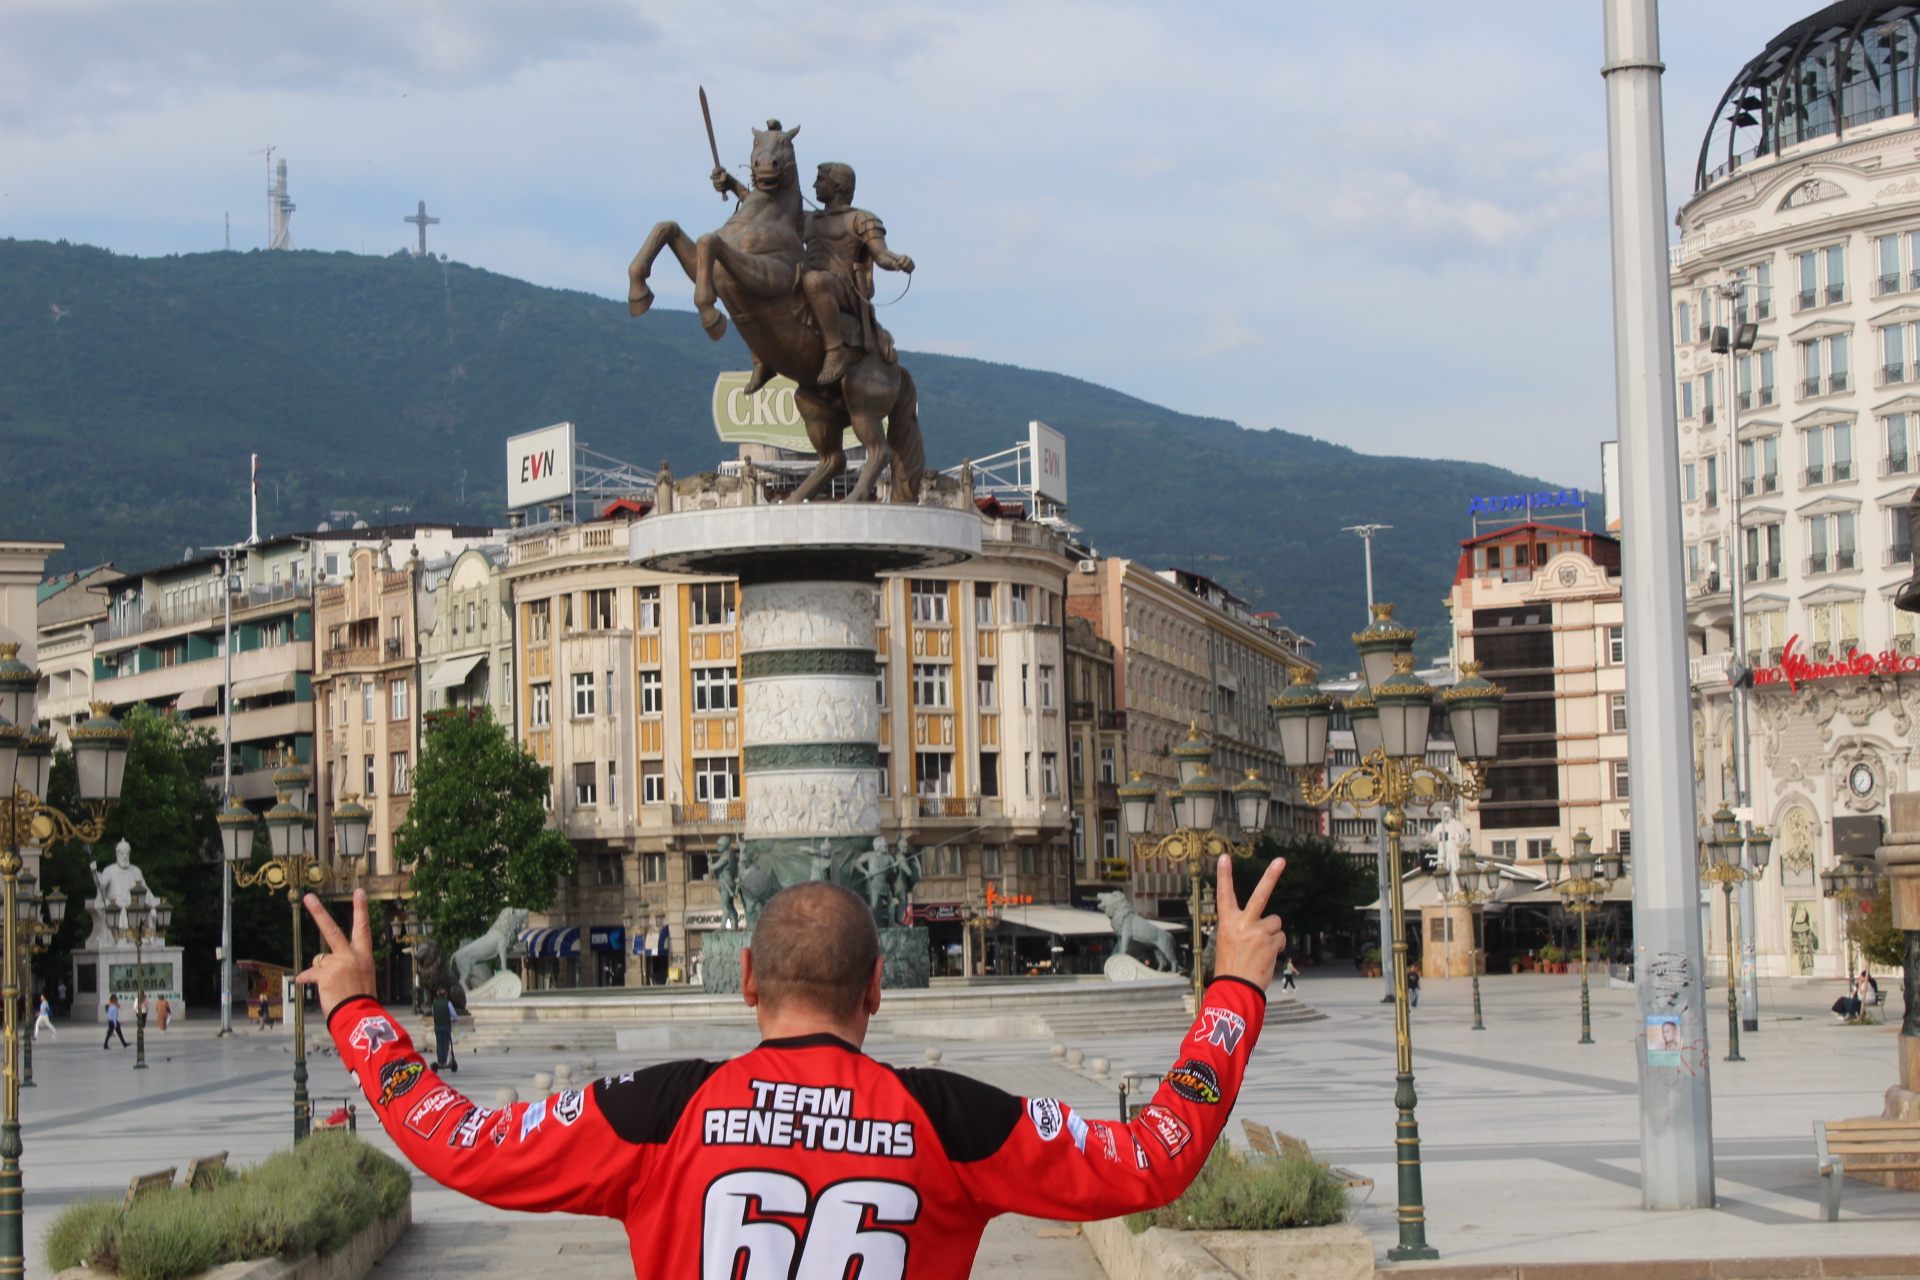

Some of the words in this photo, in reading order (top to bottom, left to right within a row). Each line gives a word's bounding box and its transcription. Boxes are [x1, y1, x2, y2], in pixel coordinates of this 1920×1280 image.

[727, 387, 805, 426] СКО
[521, 449, 554, 484] EVN
[1044, 447, 1060, 479] EVN
[1467, 487, 1589, 516] ADMIRAL
[752, 1079, 851, 1117] TEAM
[705, 1109, 914, 1156] RENE-TOURS
[1156, 1119, 1179, 1146] MR.
[703, 1170, 920, 1280] 66
